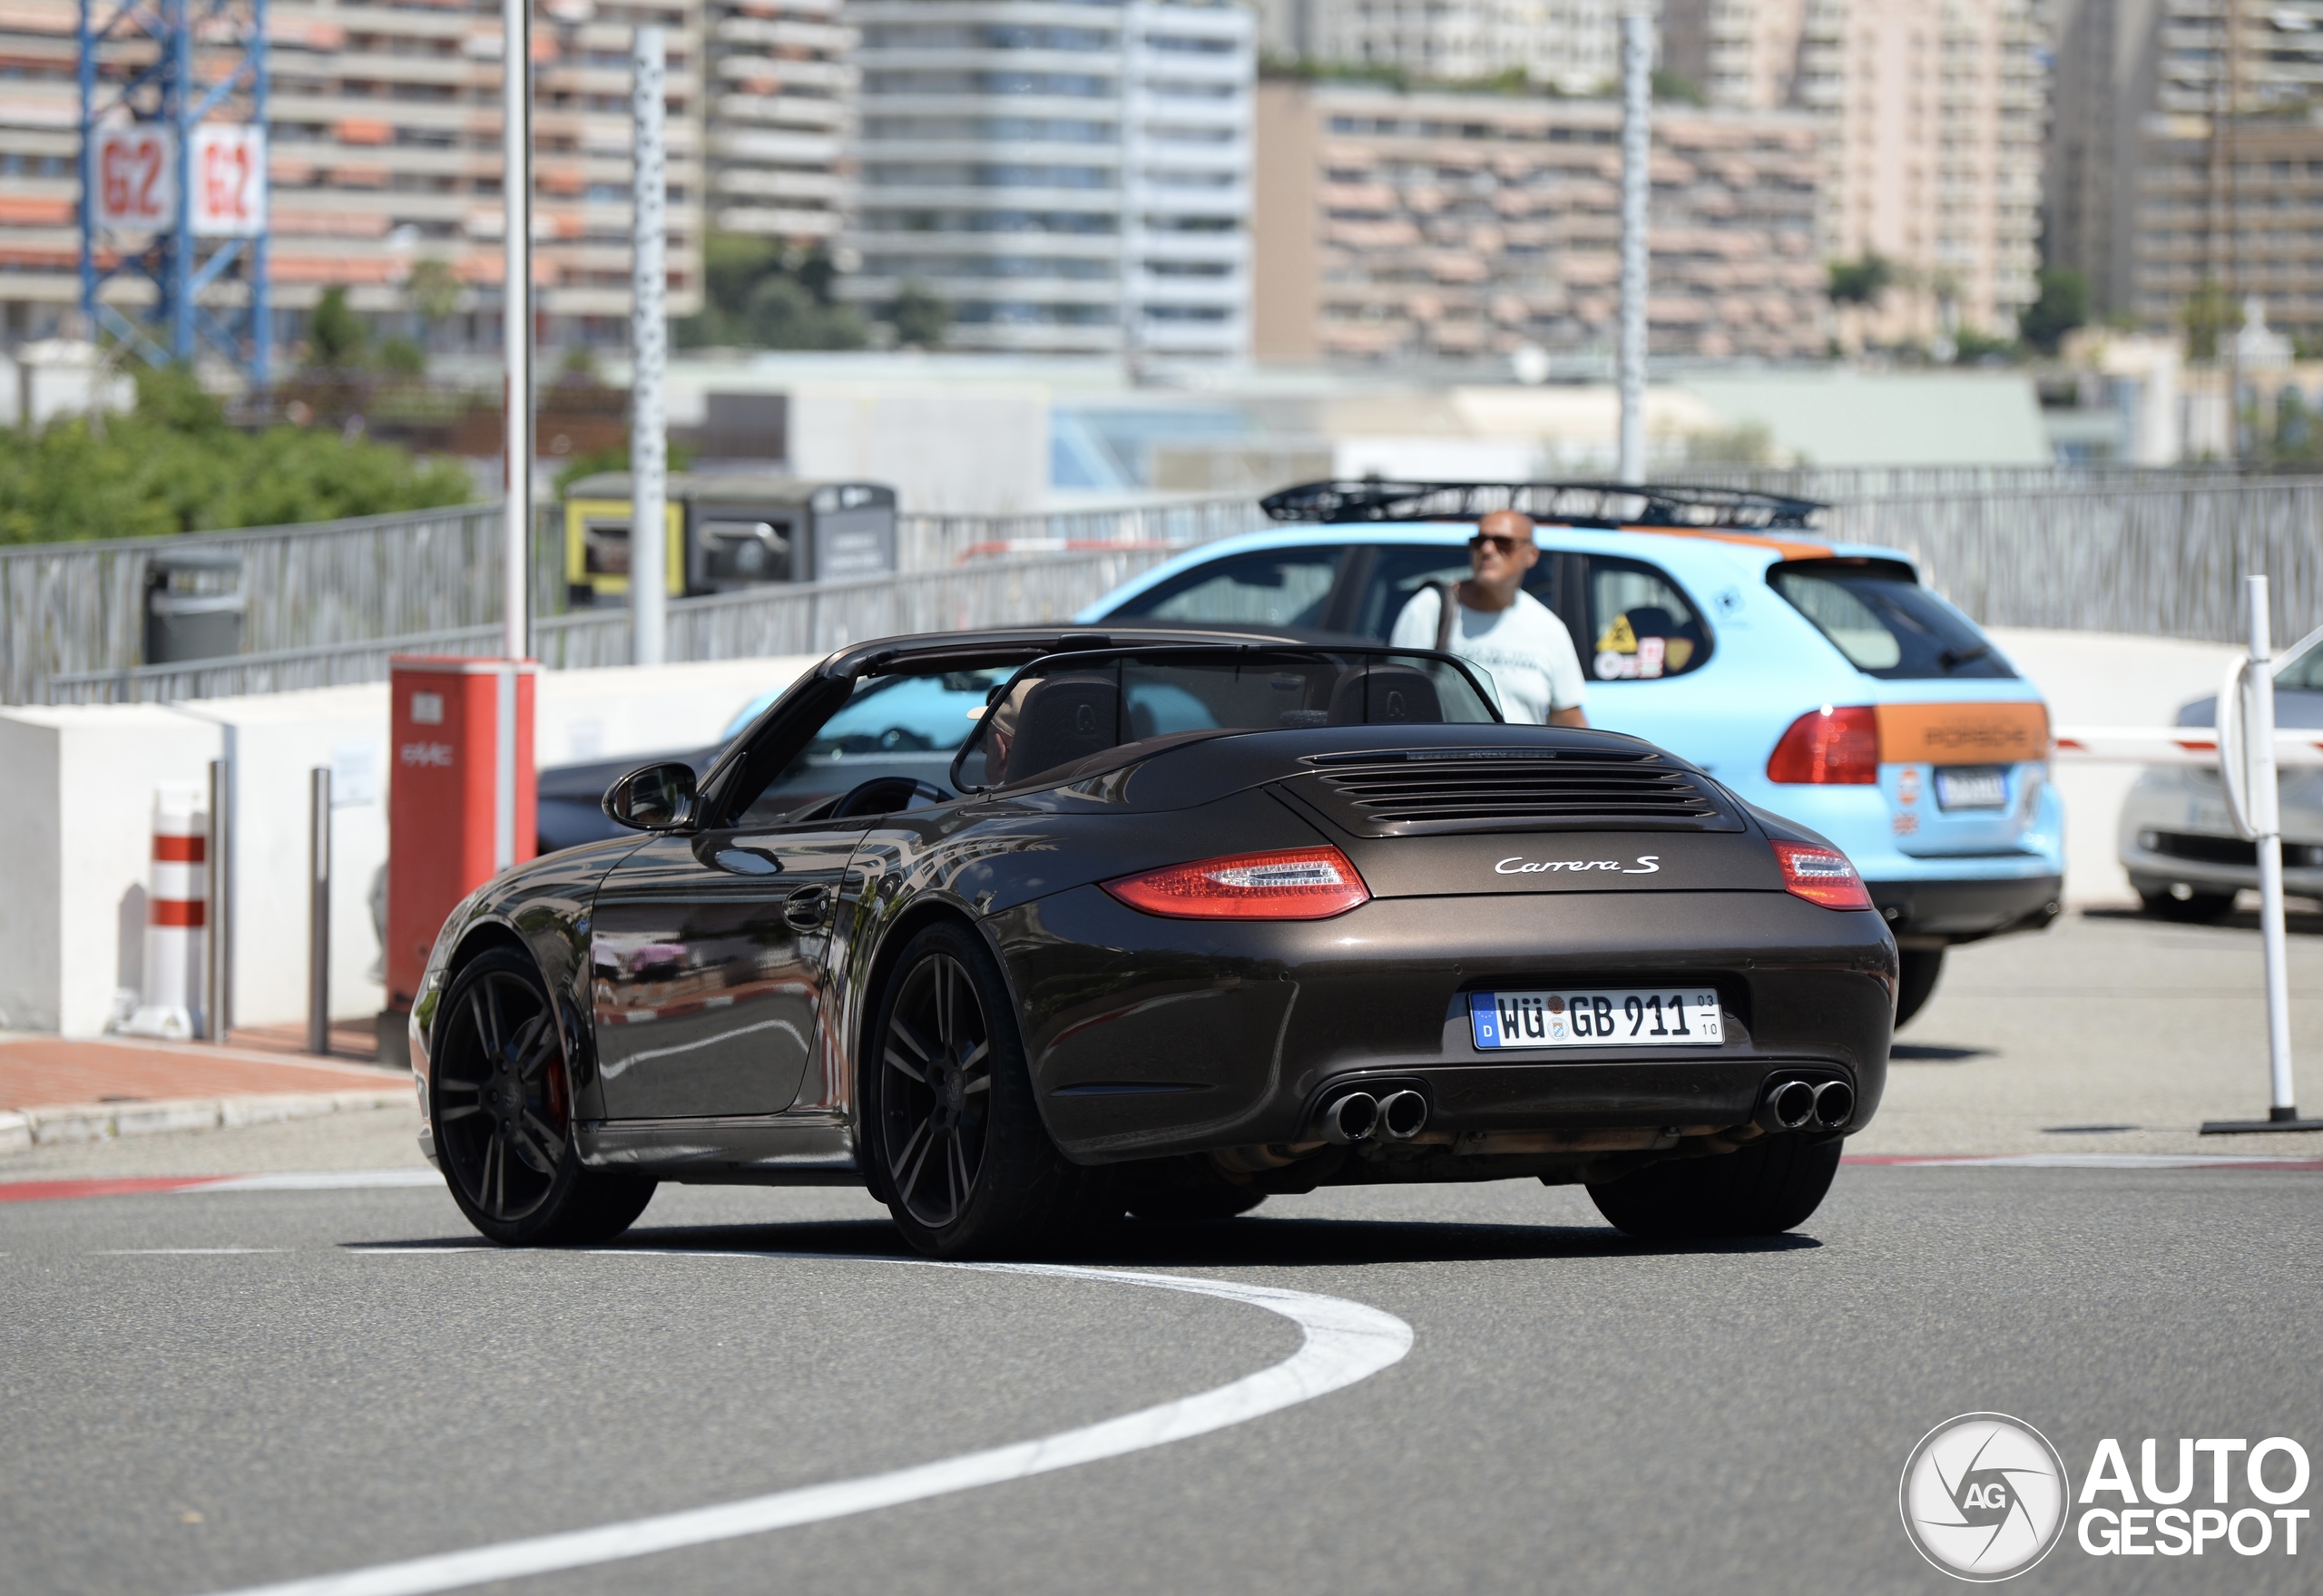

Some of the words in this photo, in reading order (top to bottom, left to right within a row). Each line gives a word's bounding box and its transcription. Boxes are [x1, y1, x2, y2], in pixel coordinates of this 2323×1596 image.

[1495, 857, 1622, 875] Carrera
[1622, 856, 1660, 874] S
[1698, 995, 1715, 1007] 03
[1569, 996, 1615, 1037] GB
[1624, 994, 1691, 1036] 911
[1483, 1024, 1494, 1038] D
[1702, 1023, 1718, 1035] 10
